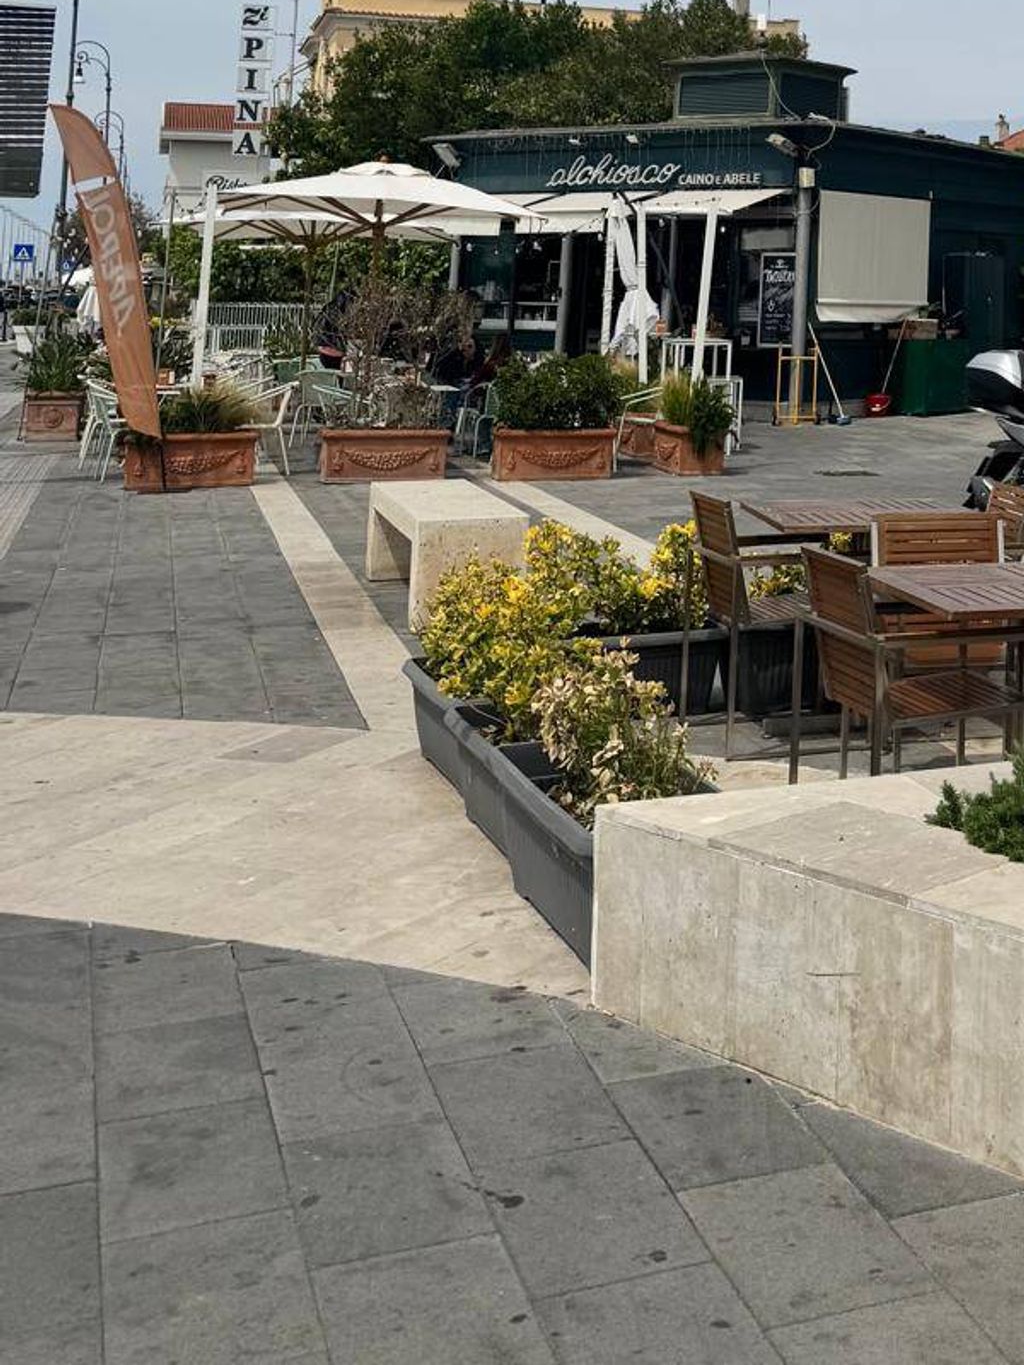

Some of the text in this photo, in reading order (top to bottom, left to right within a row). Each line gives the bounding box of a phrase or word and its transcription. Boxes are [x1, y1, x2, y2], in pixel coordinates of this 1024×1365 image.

[233, 37, 264, 155] PINA
[678, 173, 714, 185] CAINO
[723, 172, 761, 185] ABELE
